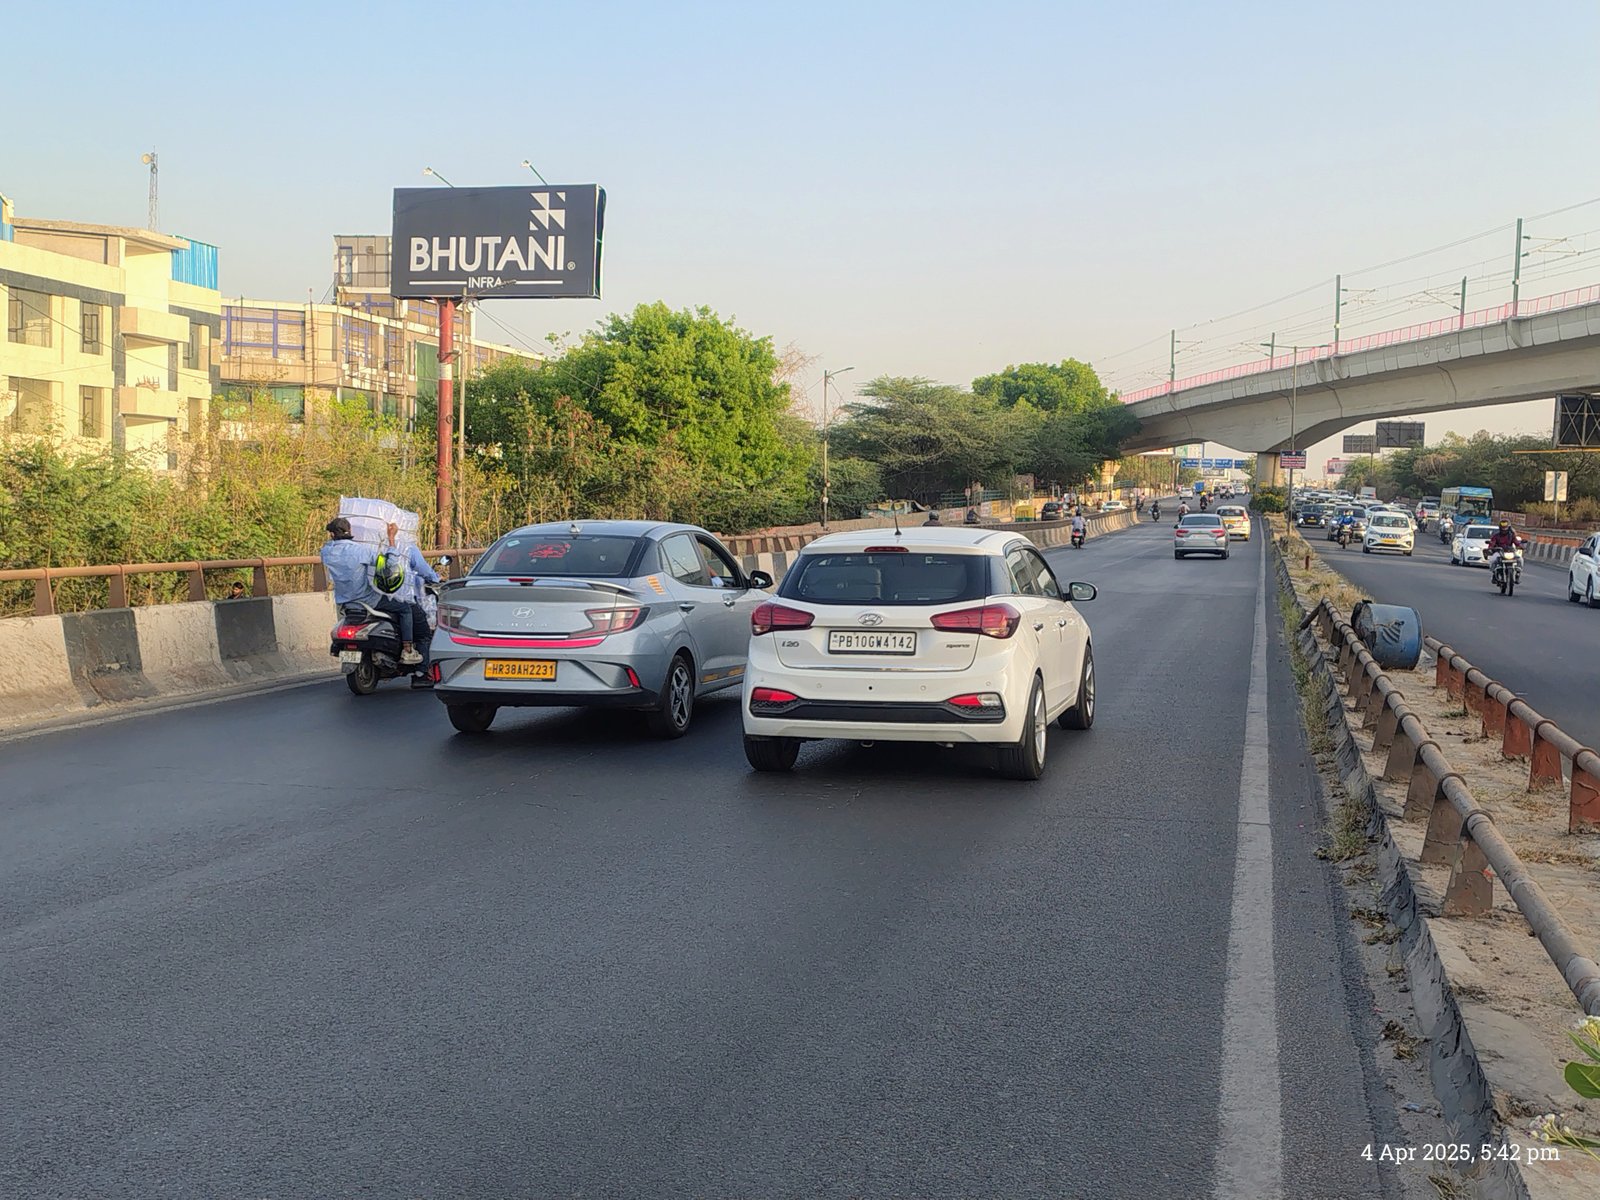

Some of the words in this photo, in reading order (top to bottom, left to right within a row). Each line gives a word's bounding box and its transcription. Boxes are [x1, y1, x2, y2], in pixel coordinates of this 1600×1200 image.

[409, 236, 565, 272] BHUTANI
[468, 276, 502, 289] INFRA
[838, 635, 913, 649] PB10GW4142
[492, 663, 554, 676] HR38AH2231
